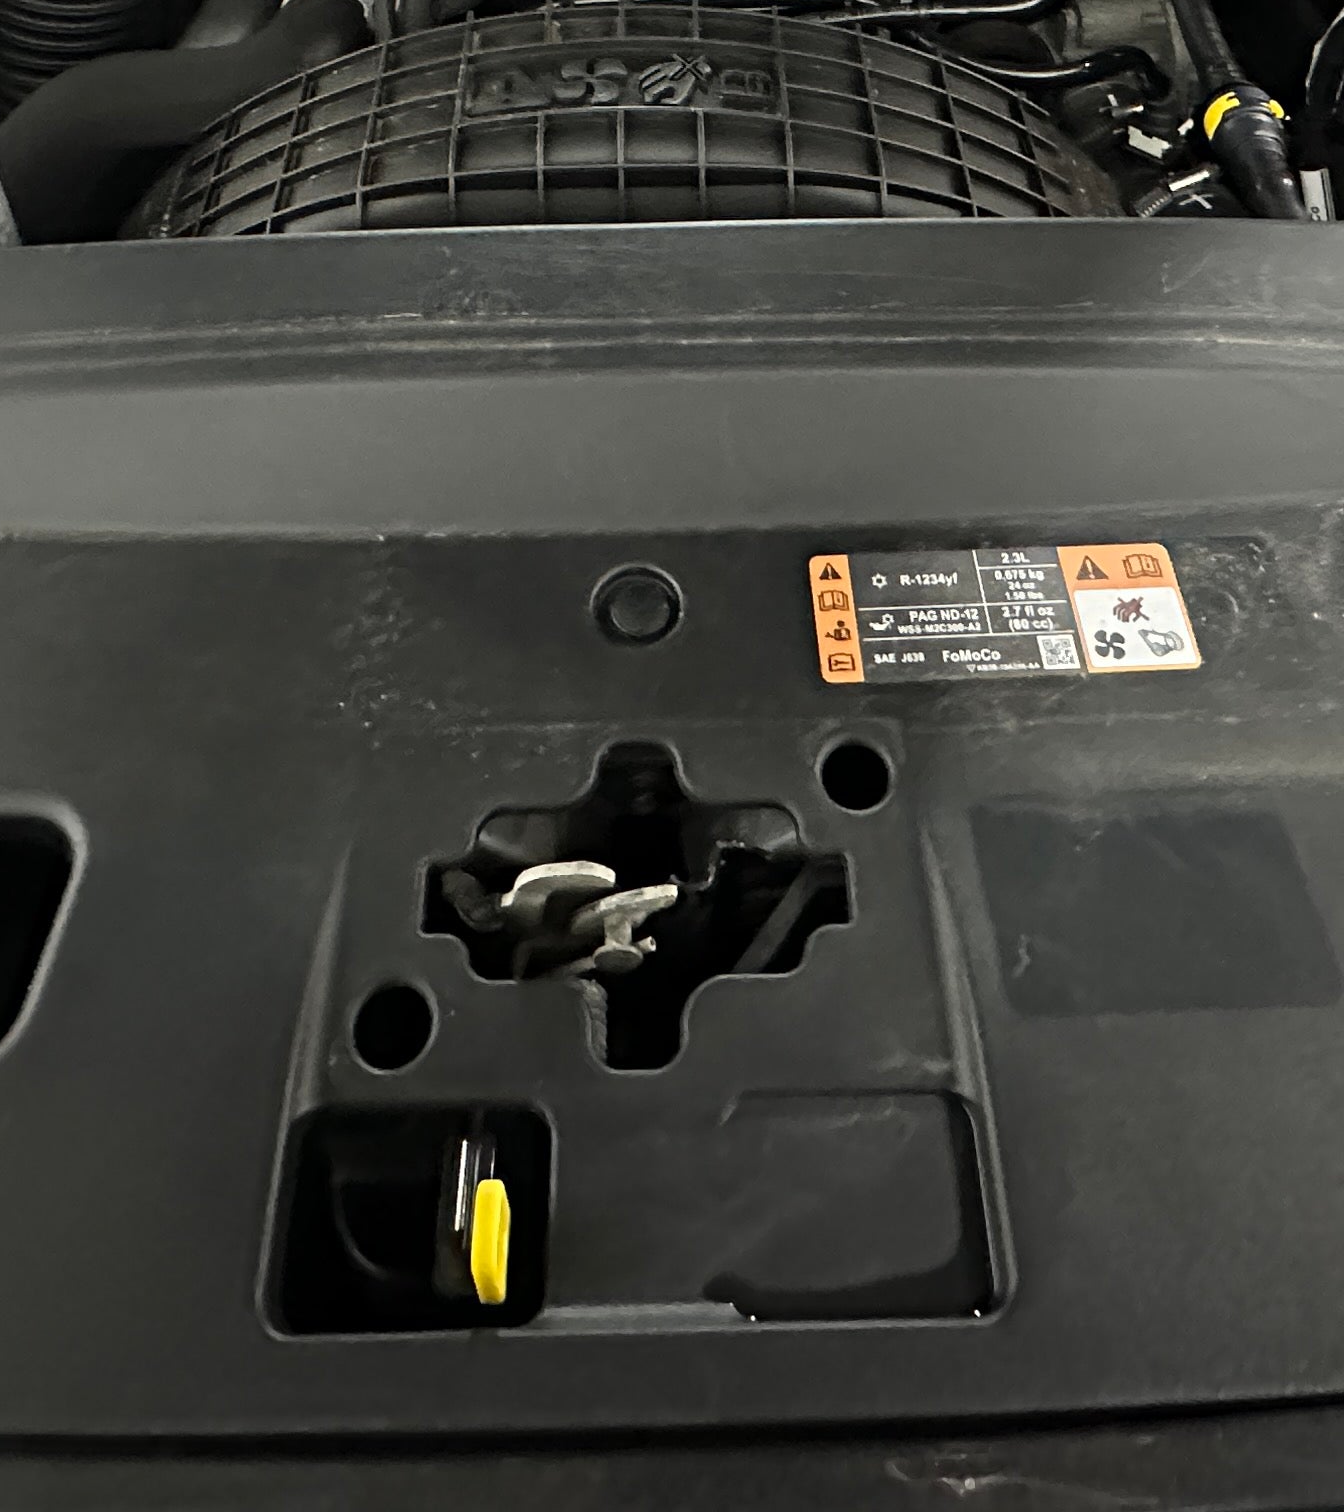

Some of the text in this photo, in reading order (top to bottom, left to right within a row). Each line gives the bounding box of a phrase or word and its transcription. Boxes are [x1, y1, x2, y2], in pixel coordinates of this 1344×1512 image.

[1001, 552, 1030, 564] 2.3L
[899, 572, 958, 586] R-1234yf
[1027, 569, 1045, 581] kg
[909, 608, 979, 623] PAG ND-12
[1001, 605, 1055, 618] 2.7 fl oz
[1032, 617, 1054, 632] cc)
[874, 652, 897, 664] SAE
[942, 648, 1001, 663] FoMoCo
